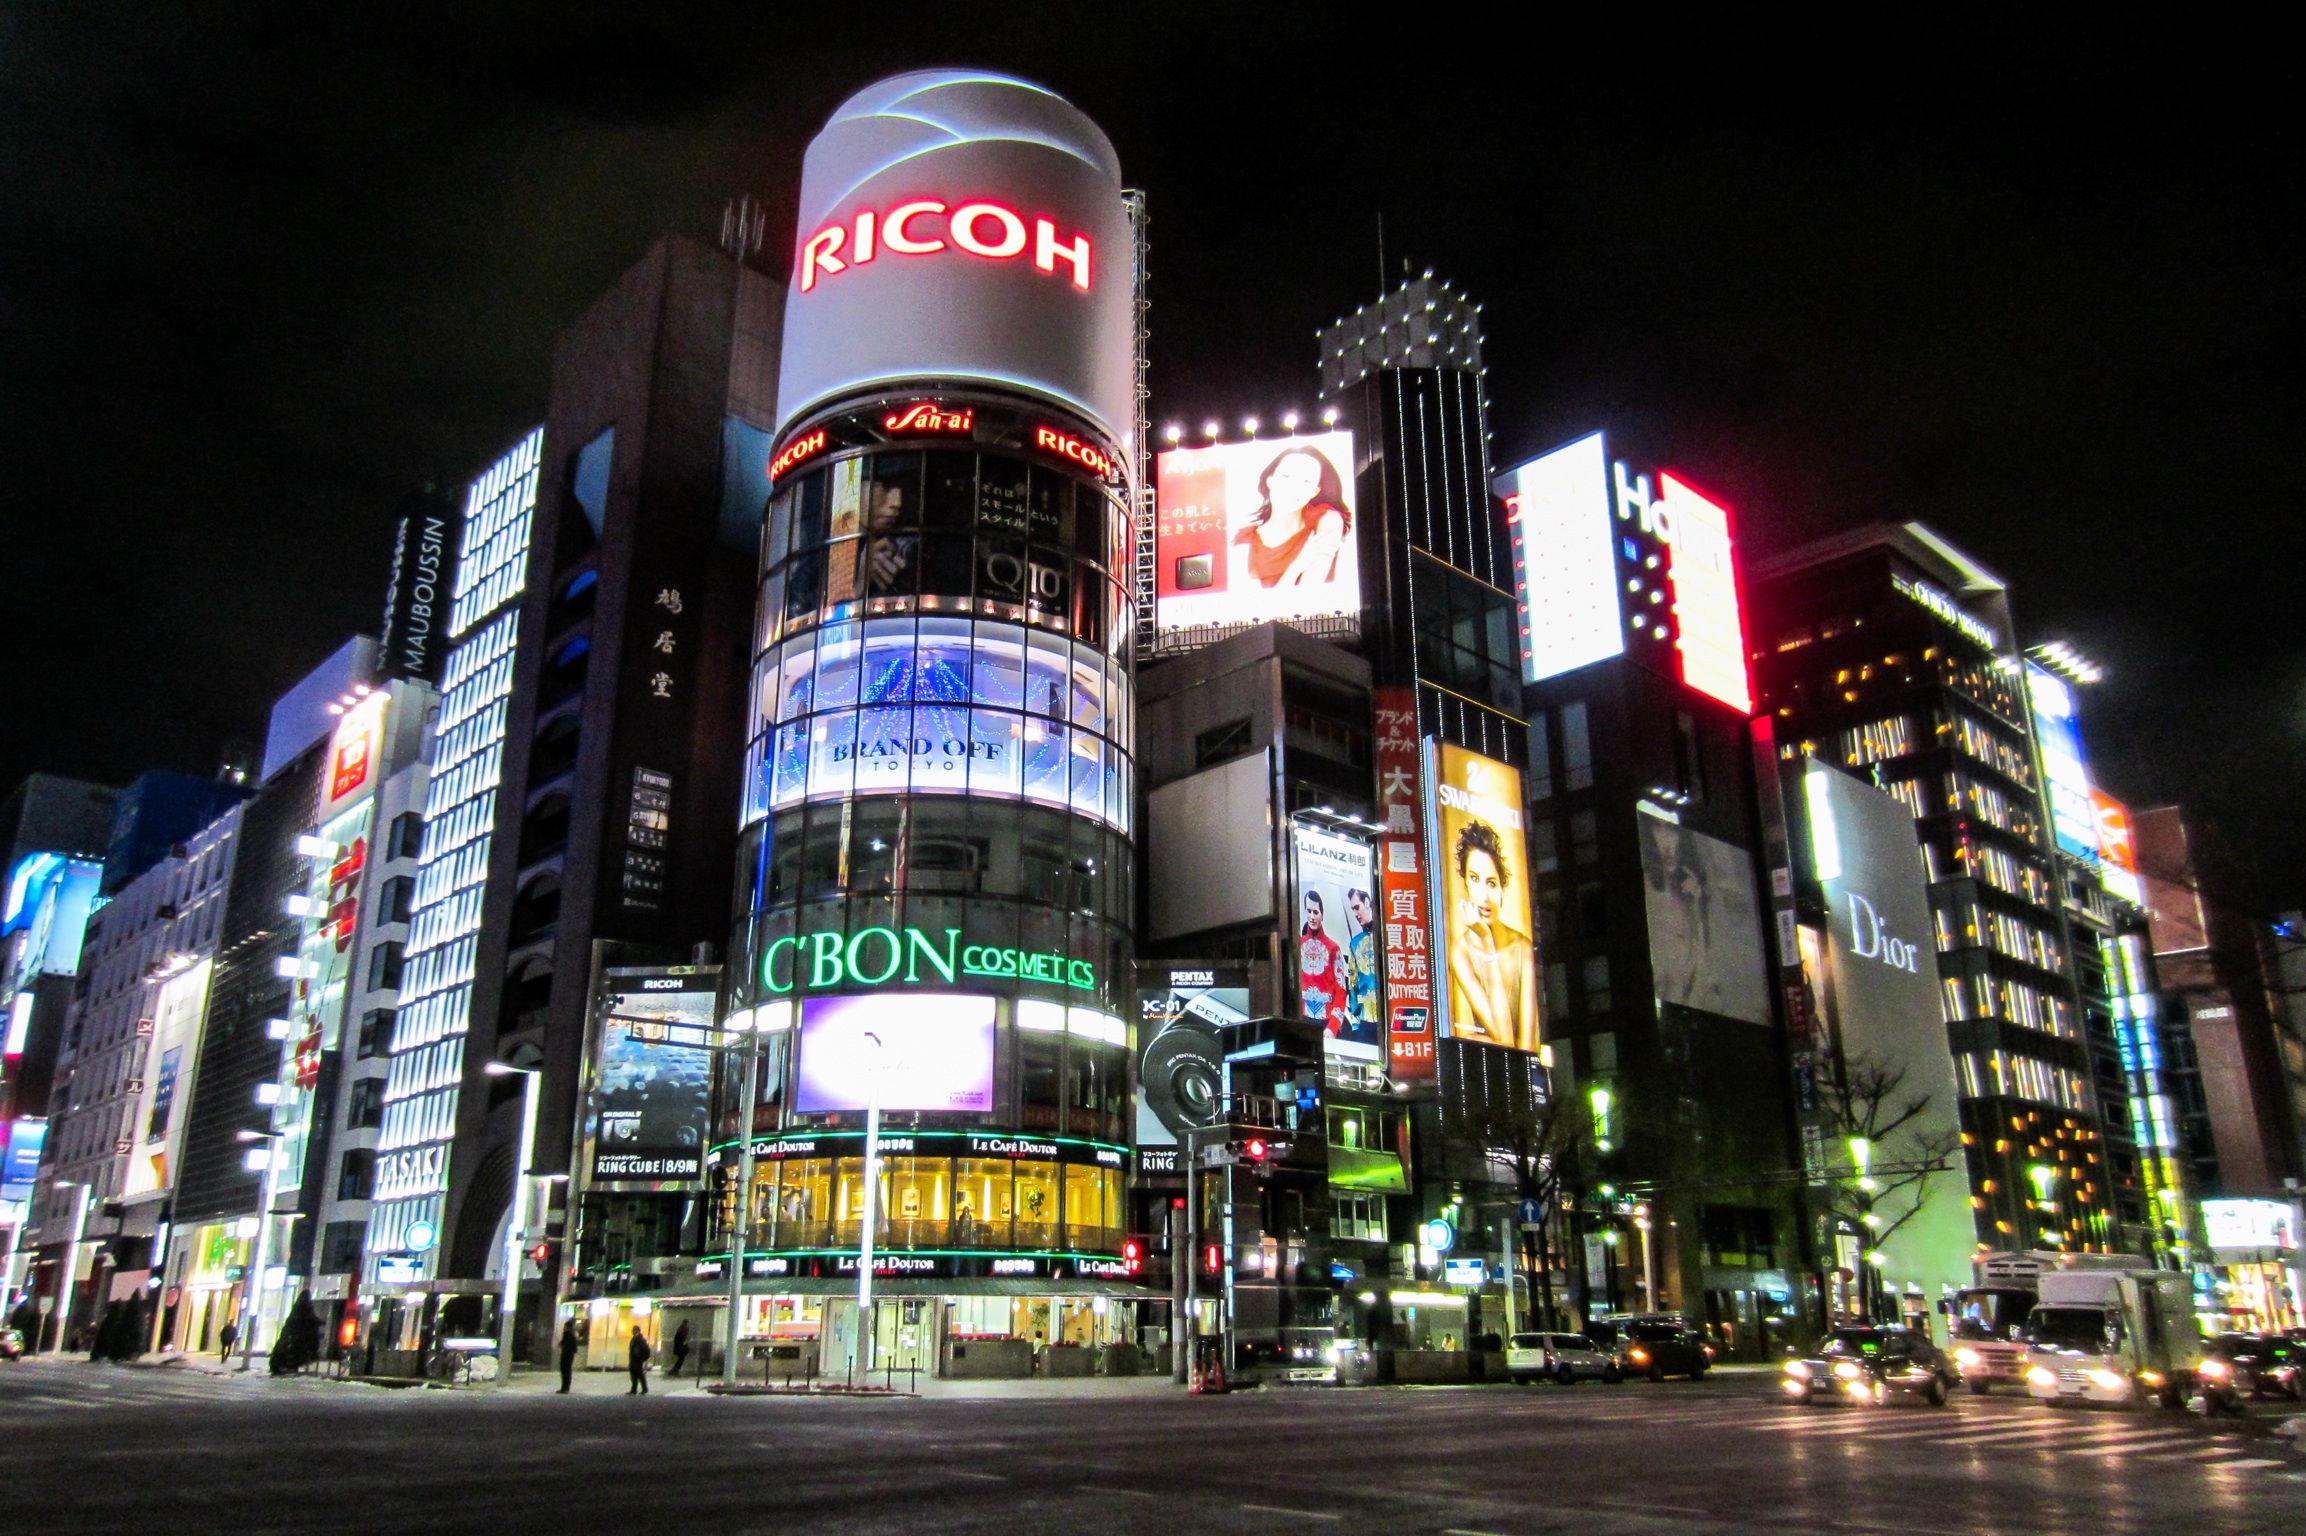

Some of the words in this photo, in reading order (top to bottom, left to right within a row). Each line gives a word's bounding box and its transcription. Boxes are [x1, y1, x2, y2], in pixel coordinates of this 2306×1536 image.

[800, 201, 1090, 293] RICOH
[886, 405, 973, 430] San-ai
[769, 431, 824, 481] RICOH
[1038, 428, 1112, 477] RICOH
[404, 517, 445, 672] MAUBOUSSIN
[651, 589, 682, 698] 鳩居堂
[834, 738, 932, 762] BRAND
[943, 738, 1003, 760] OFF
[873, 761, 954, 771] TOYO
[1384, 766, 1418, 873] 大黒屋
[1440, 784, 1520, 830] SWARKI
[1301, 841, 1347, 862] LILANZ
[1390, 889, 1418, 920] 質
[1386, 924, 1425, 950] 買取
[1843, 891, 1918, 973] Dior
[764, 928, 961, 993] C'BON
[963, 946, 1095, 987] COSMETICS
[1388, 953, 1427, 980] 販売
[644, 979, 683, 989] RICOH
[1171, 971, 1214, 981] PENTAX
[1388, 982, 1429, 1000] DUTYFREE
[1395, 1013, 1425, 1022] UnionPay
[1405, 1042, 1432, 1057] B1F
[1020, 1141, 1058, 1154] DOUTOR
[377, 1145, 446, 1184] TASAKI
[598, 1160, 627, 1173] RING
[629, 1160, 660, 1173] CUBE
[666, 1160, 698, 1173] 8/9階
[1143, 1158, 1175, 1170] RING
[856, 1257, 886, 1269] CFÉ
[888, 1257, 934, 1269] DOUTOR
